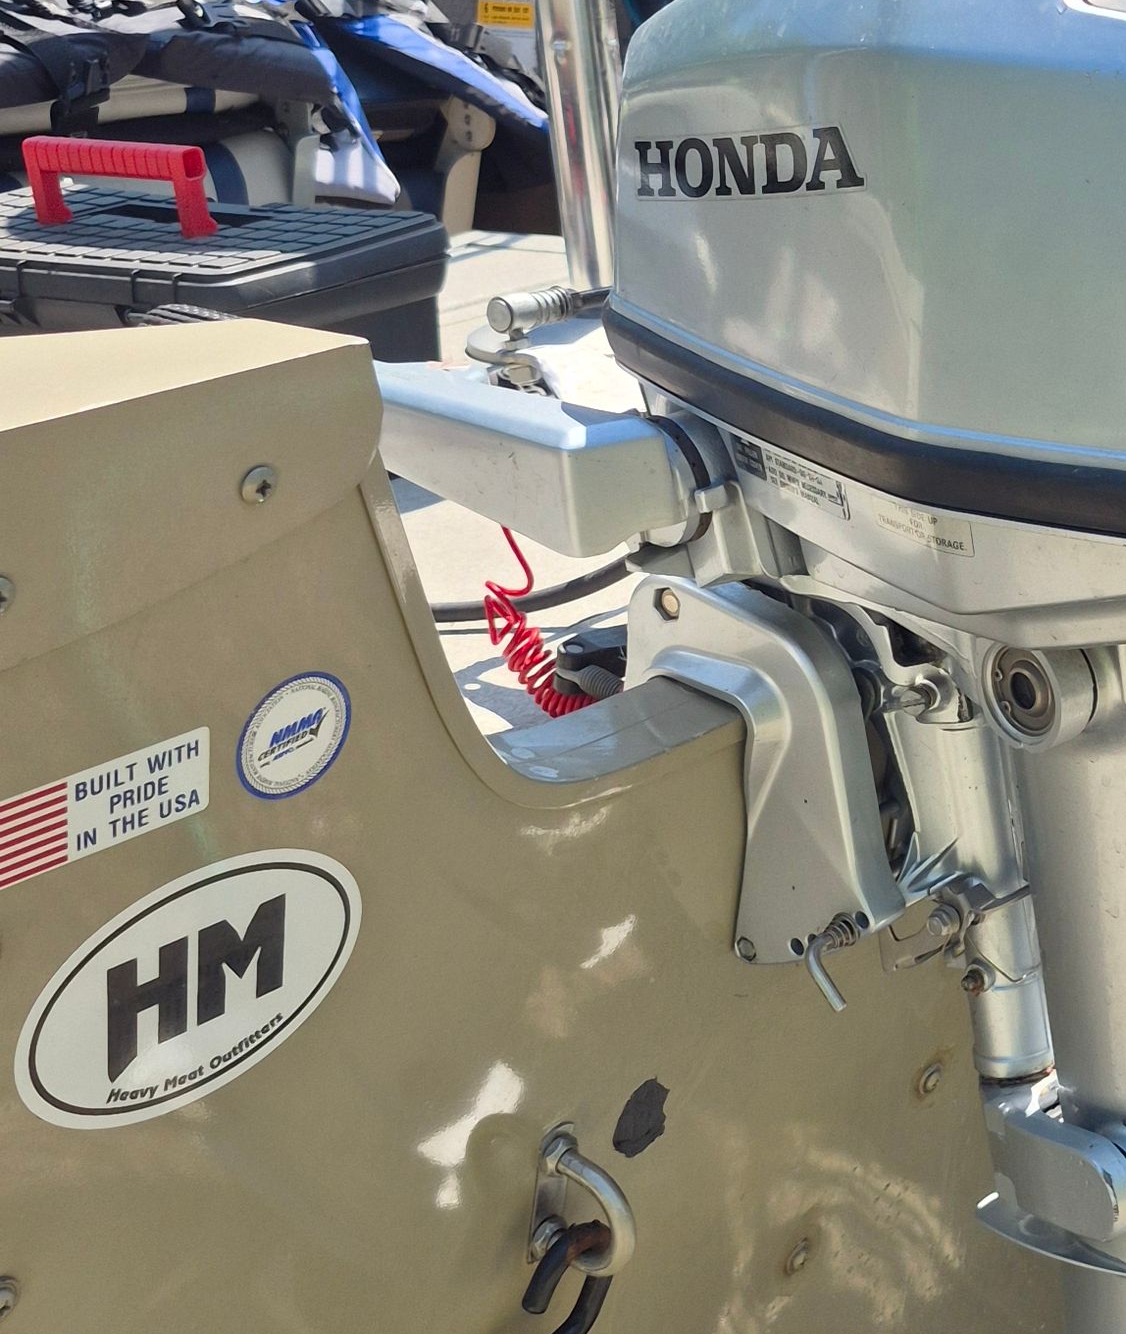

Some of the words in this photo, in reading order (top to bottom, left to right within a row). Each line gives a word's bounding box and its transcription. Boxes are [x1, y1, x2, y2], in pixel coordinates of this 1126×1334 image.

[634, 126, 865, 198] HONDA
[928, 516, 938, 526] UP
[74, 762, 138, 802] BUILT
[146, 739, 200, 774] WITH
[257, 730, 308, 762] CERTIFIED
[76, 827, 97, 851] IN
[108, 807, 150, 838] THE
[159, 788, 200, 819] USA
[109, 775, 169, 814] PRIDE
[106, 893, 286, 1083] HM
[106, 1083, 159, 1115] Heavy
[163, 1065, 205, 1092] Meat
[208, 1012, 284, 1070] Outfitters
